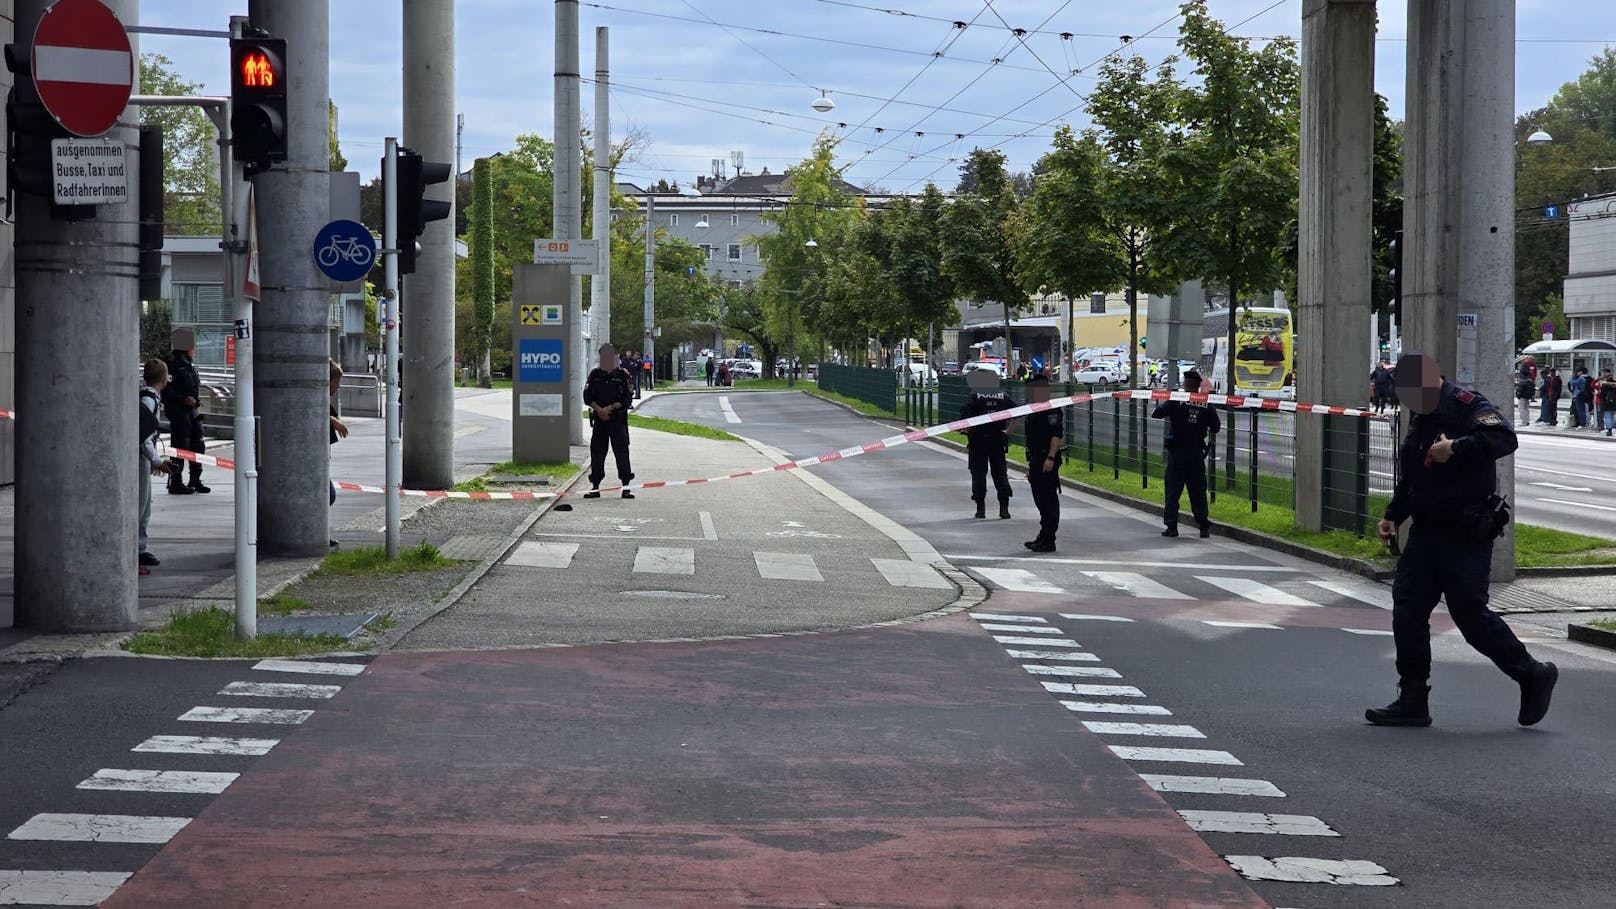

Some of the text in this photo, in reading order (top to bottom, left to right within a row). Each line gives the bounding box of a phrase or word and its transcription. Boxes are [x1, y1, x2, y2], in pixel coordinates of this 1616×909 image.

[56, 146, 122, 159] ausgenommen
[108, 163, 124, 176] und
[57, 183, 126, 196] RadfahrerInnen
[521, 353, 560, 364] HYPO
